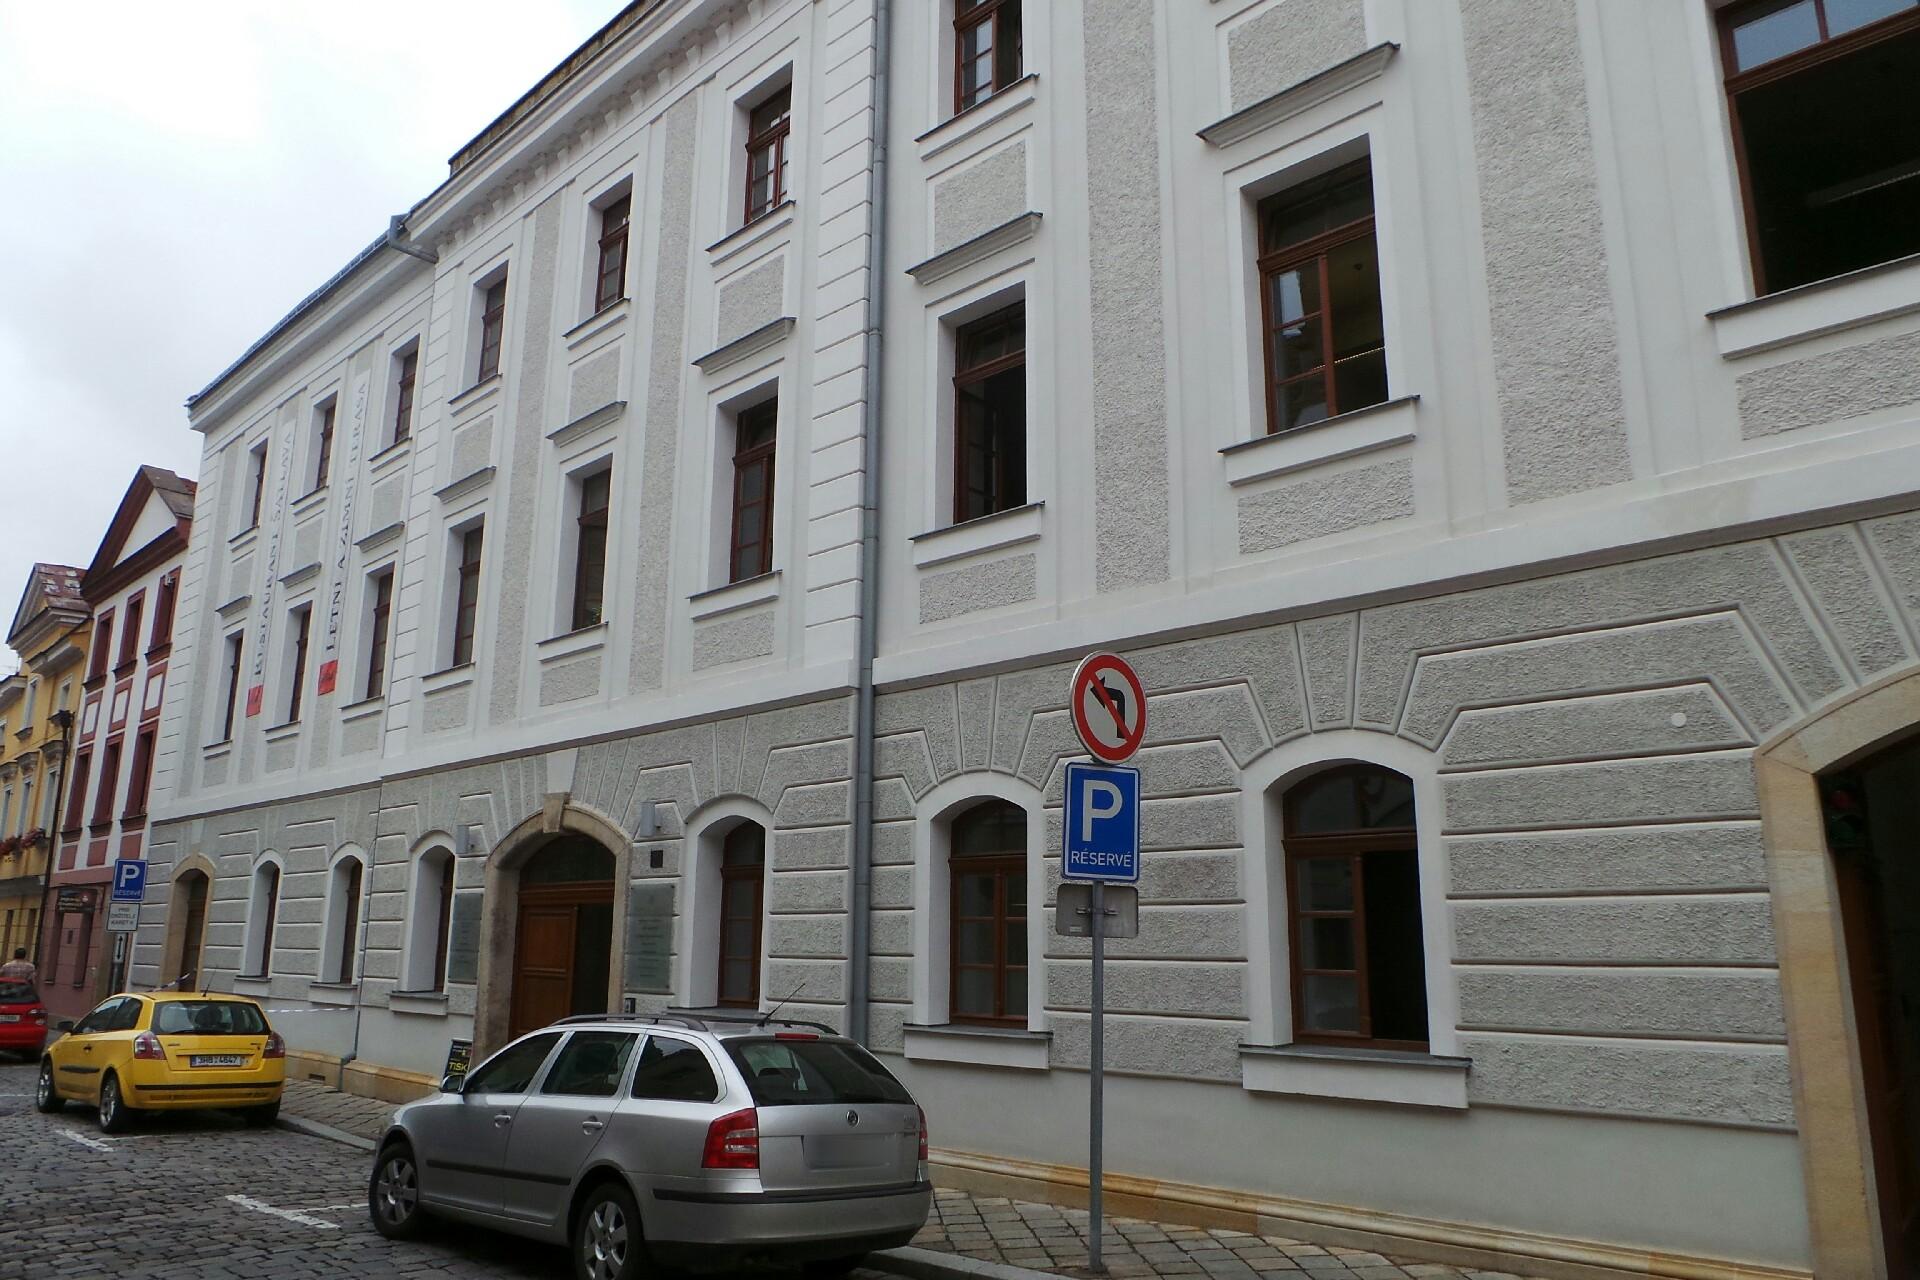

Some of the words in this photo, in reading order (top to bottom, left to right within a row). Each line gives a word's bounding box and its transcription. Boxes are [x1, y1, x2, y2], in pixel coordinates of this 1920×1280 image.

[337, 556, 346, 569] A
[1082, 779, 1123, 841] P
[1071, 848, 1132, 867] RÉSERVÉ
[119, 864, 140, 888] P
[449, 1061, 468, 1071] TISK
